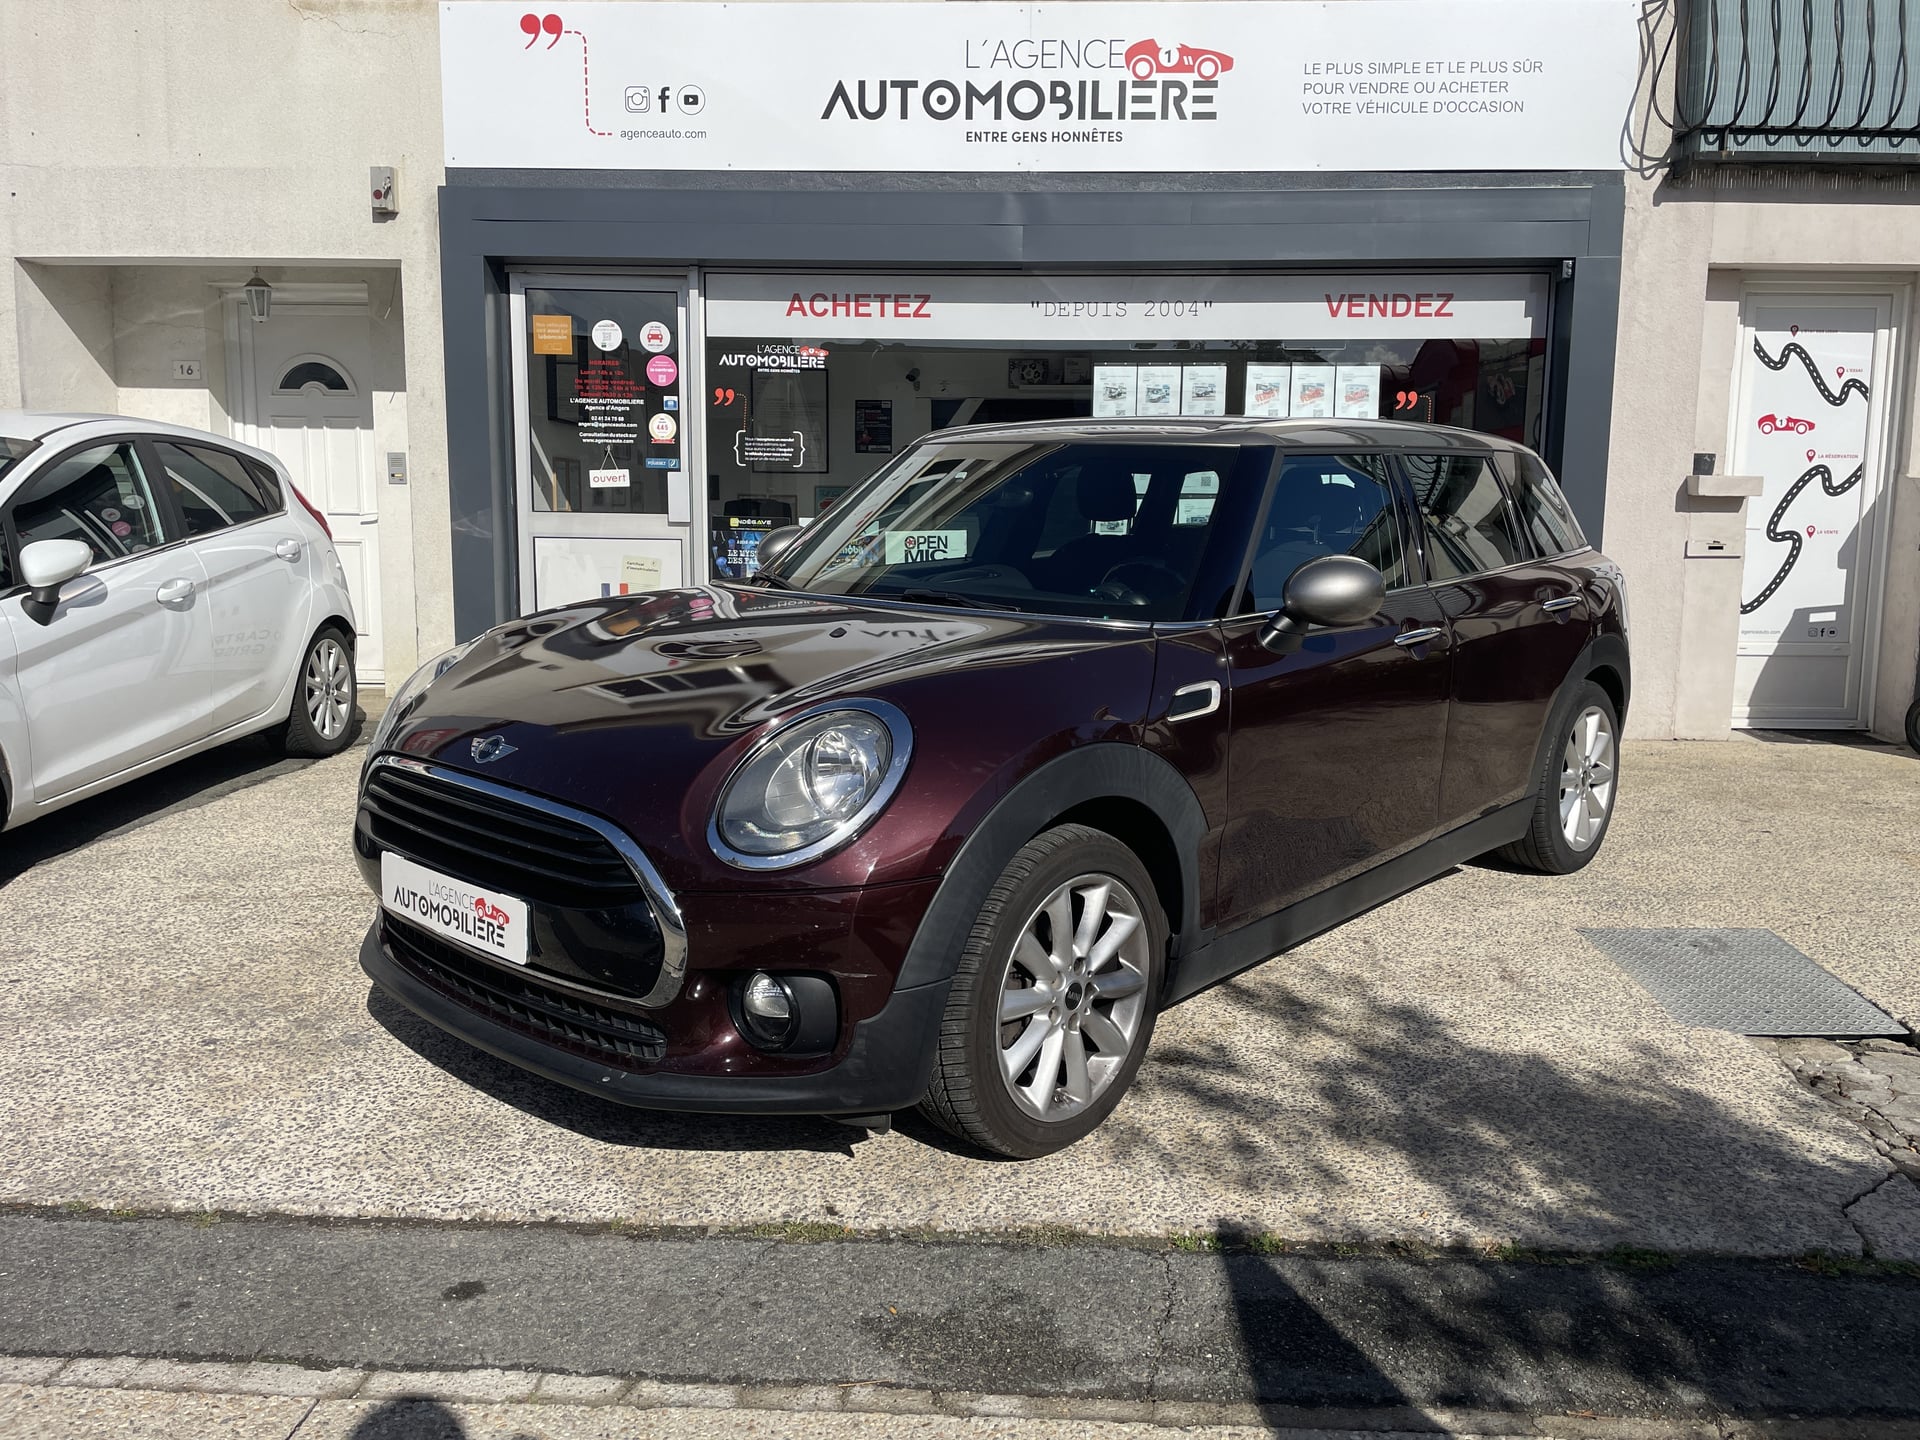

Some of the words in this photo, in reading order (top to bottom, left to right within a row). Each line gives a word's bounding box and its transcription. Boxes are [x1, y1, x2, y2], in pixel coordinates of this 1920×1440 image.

[965, 39, 1125, 69] L'AGENCE
[1304, 63, 1321, 75] LE
[1325, 62, 1363, 75] PLUS
[1367, 62, 1421, 75] SIMPLE
[1425, 62, 1444, 74] ET
[1448, 62, 1465, 73] LE
[1470, 61, 1508, 73] PLUS
[1512, 58, 1543, 73] SÛR
[1303, 83, 1345, 95] POUR
[1349, 82, 1409, 94] VENDRE
[1413, 81, 1436, 94] OU
[1438, 81, 1509, 93] ACHETER
[1302, 102, 1351, 114] VOTRE
[1356, 100, 1429, 114] VÉHICULE
[1433, 101, 1524, 113] D'OCCASION
[620, 129, 707, 141] agenceauto.com
[965, 131, 1008, 143] ENTRE
[1011, 131, 1048, 143] GENS
[1051, 128, 1123, 143] HONNÊTES
[786, 293, 931, 318] ACHETEZ
[1325, 293, 1454, 318] VENDEZ
[757, 344, 800, 354] L'AGENCE
[180, 364, 193, 375] 16
[592, 473, 626, 483] ouvert
[904, 535, 948, 550] OPEN
[428, 880, 475, 911] L'AGENCE
